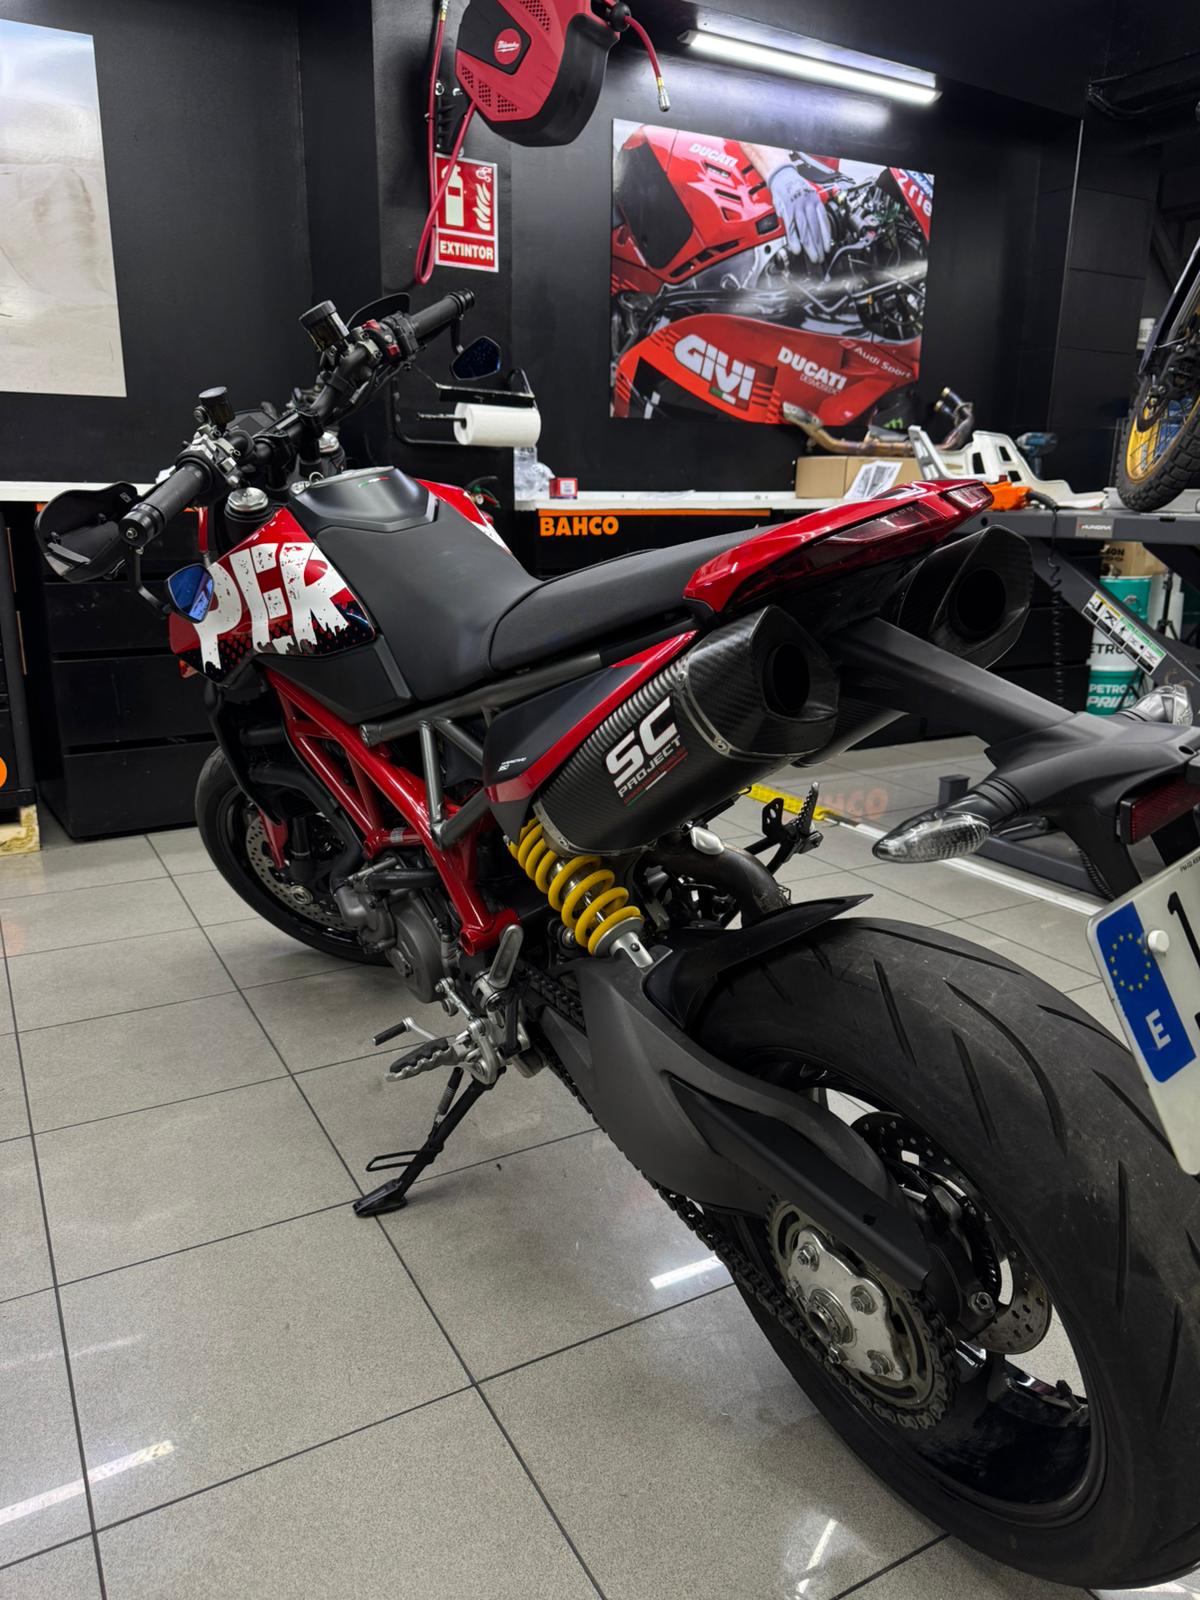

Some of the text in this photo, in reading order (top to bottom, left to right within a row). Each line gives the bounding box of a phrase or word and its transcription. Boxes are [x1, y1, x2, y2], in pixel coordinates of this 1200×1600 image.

[689, 143, 739, 167] DUCATI
[440, 240, 493, 260] EXTINTOR
[674, 333, 756, 401] GIVI
[777, 346, 848, 390] DUCATI
[854, 346, 913, 379] Audi Sport
[539, 516, 620, 537] BAHCO
[605, 696, 678, 788] SC
[617, 734, 681, 798] PROJECT
[1145, 1008, 1171, 1050] E
